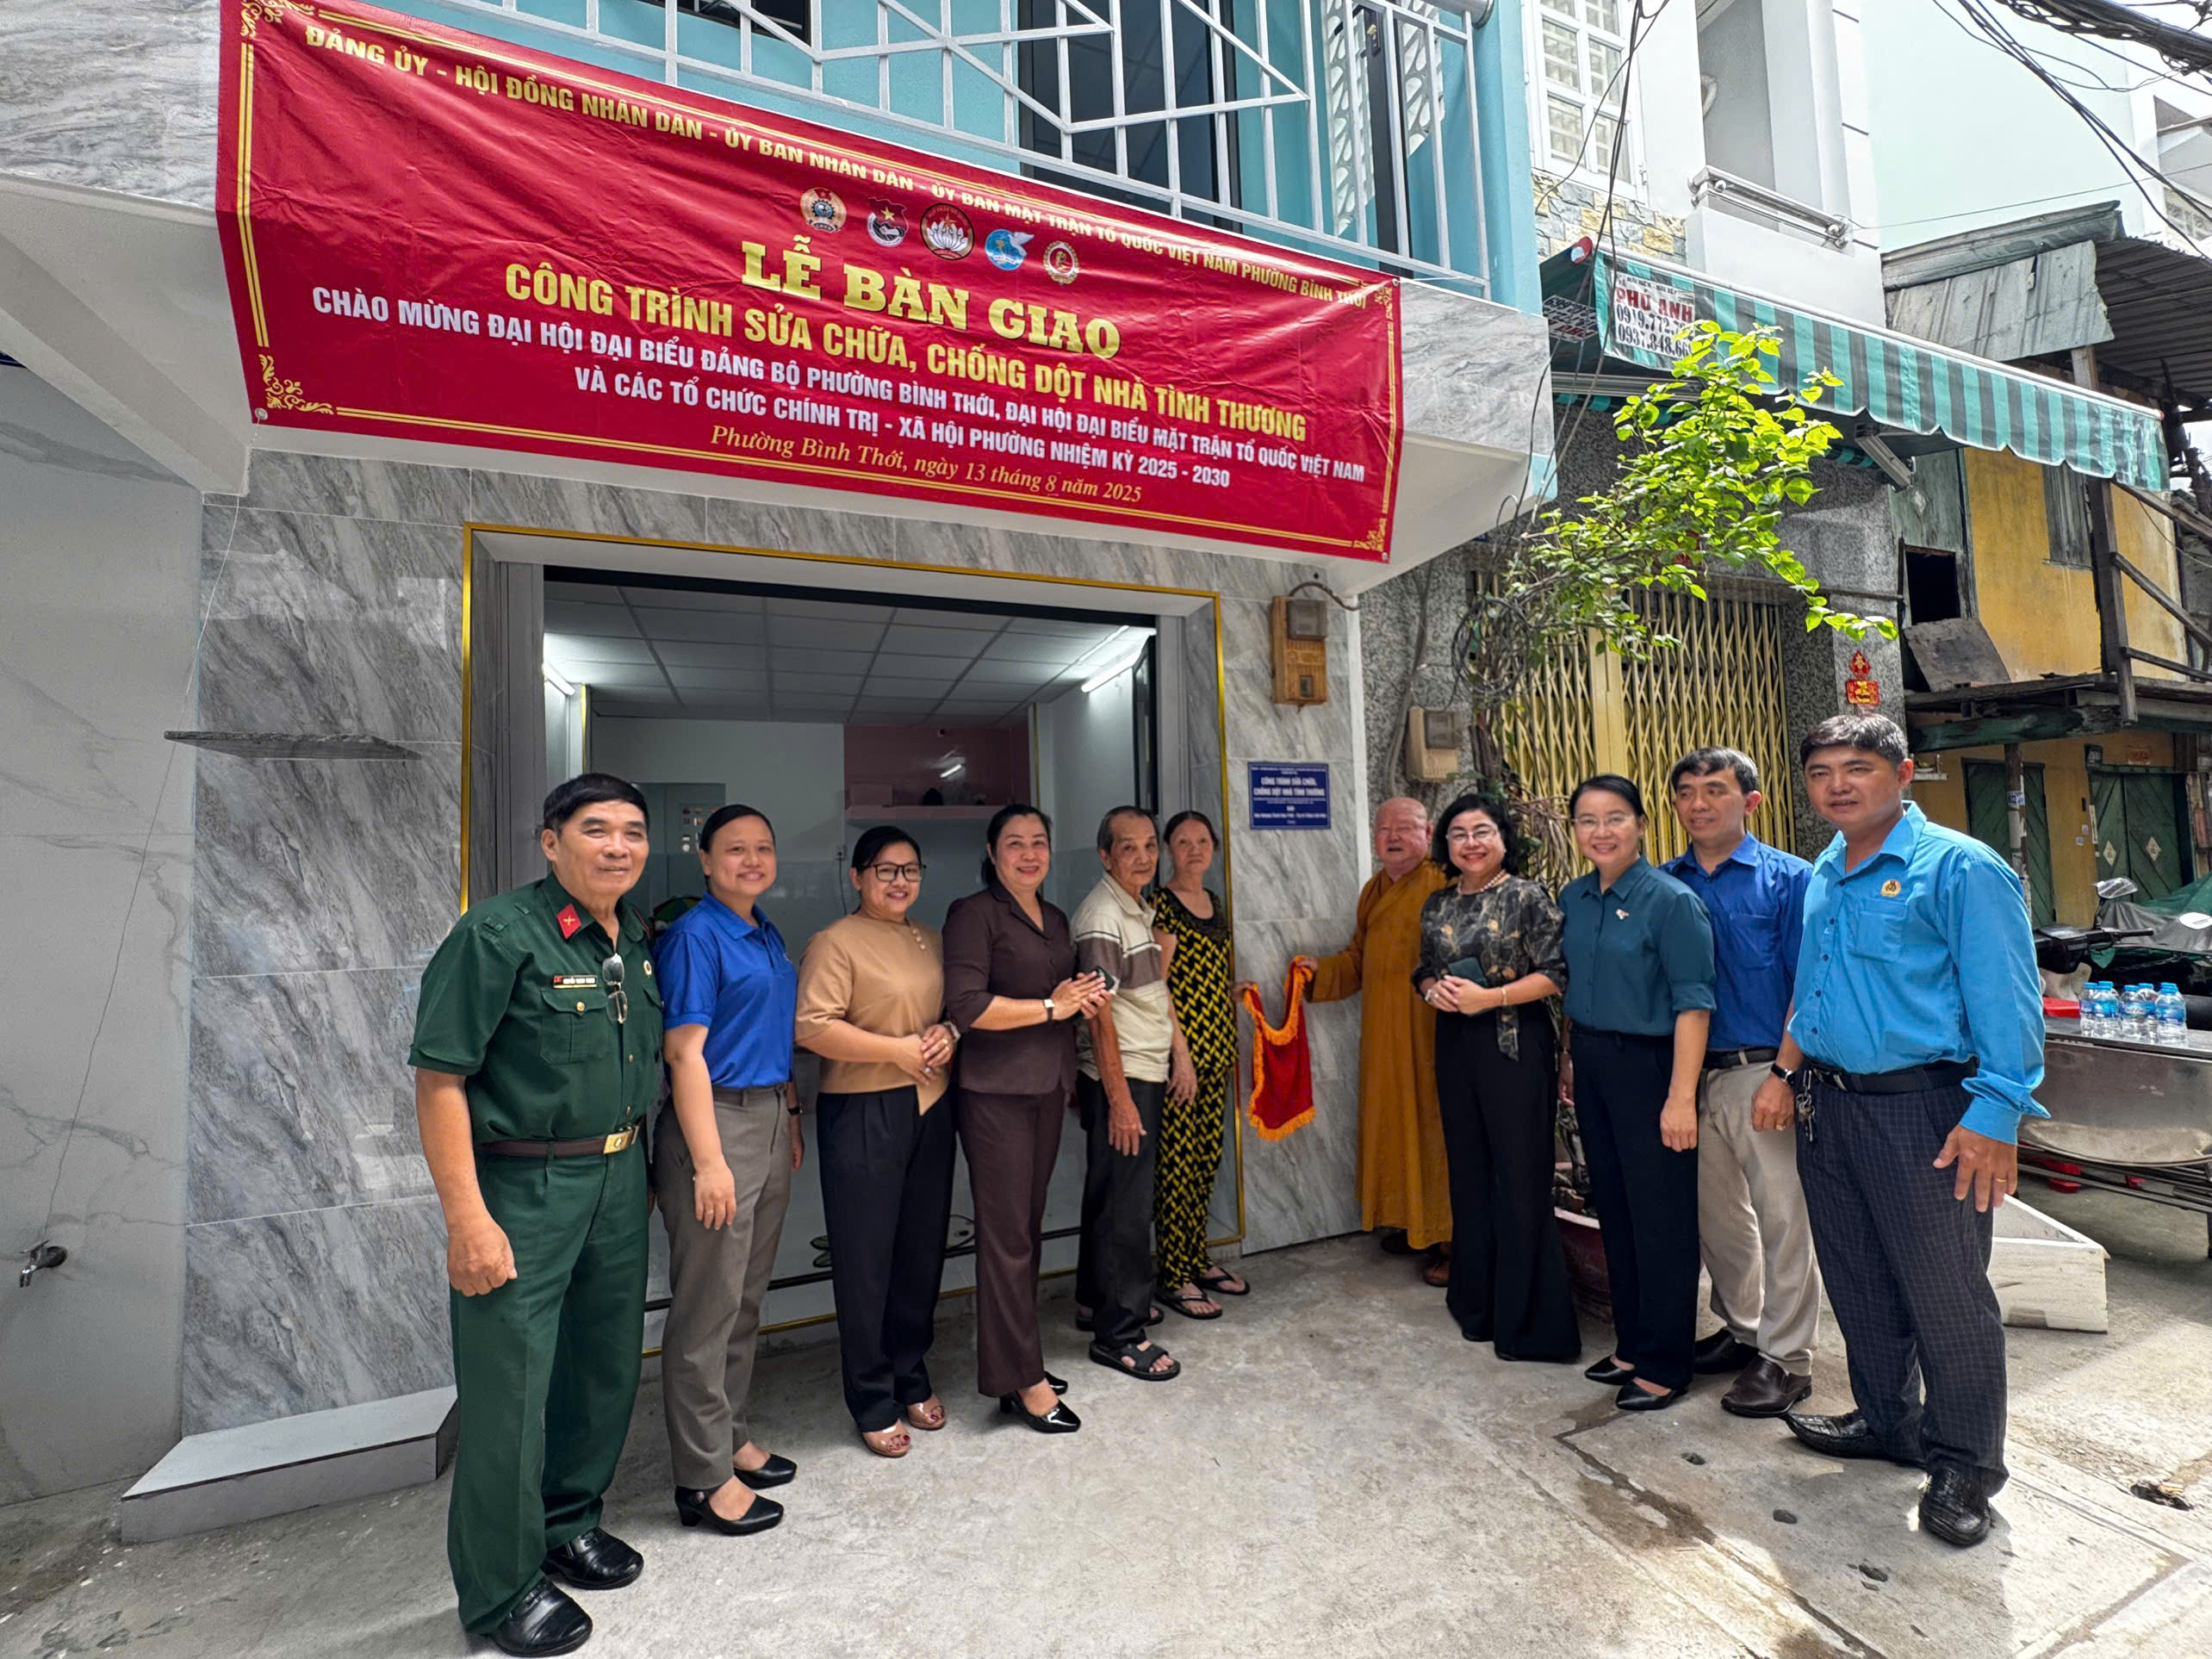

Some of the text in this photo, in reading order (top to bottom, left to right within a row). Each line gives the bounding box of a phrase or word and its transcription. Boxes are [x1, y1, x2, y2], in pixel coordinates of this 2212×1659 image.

[307, 24, 385, 65] ĐẢNG
[394, 45, 428, 77] ỦY
[456, 65, 498, 97] HỘI
[506, 74, 574, 112] ĐỒNG
[582, 87, 648, 128] NHÂN
[656, 107, 702, 140] DÂN
[725, 127, 753, 151] ỦY
[759, 139, 803, 164] BAN
[810, 149, 867, 179] NHÂN
[873, 168, 913, 190] DÂN
[932, 183, 955, 202] ỦY
[962, 192, 1000, 213] BAN
[1005, 206, 1041, 226] MẶT
[1047, 213, 1092, 238] TRẬN
[1097, 226, 1116, 242] TỔ
[1121, 232, 1164, 255] QUỐC
[1168, 245, 1199, 266] VIỆT
[1203, 253, 1238, 276] NAM
[1241, 262, 1297, 293] PHƯỜNG
[1300, 279, 1333, 302] BÌNH
[506, 262, 1305, 441] CÔNG TRÌNH SỬA CHỮA, CHỐNG DỘT NHÀ TÌNH THƯƠNG
[741, 235, 1122, 361] LỄ BÀN GIAO
[1619, 324, 1692, 357] 0937.848.66
[1658, 298, 1693, 323] ANH
[314, 288, 1364, 482] CHÀO MỪNG ĐẠI HỘI ĐẠI BIỂU ĐẢNG BỘ PHƯỜNG BÌNH THỚI, ĐẠI HỘI ĐẠI BIỂU MẶT TRẬN TỔ QUỐC VIỆT NAM
[575, 365, 606, 393] VÀ
[615, 372, 662, 400] CÁC
[670, 376, 699, 406] TỔ
[706, 388, 766, 415] CHỨC
[774, 398, 839, 426] CHÍNH
[847, 408, 878, 437] TRỊ
[899, 416, 925, 439] XÃ
[931, 421, 964, 449] HỘI
[970, 428, 1045, 458] PHƯỜNG
[1051, 436, 1107, 469] NHIỆM
[1113, 450, 1134, 471] KỲ
[1138, 457, 1177, 478] 2025
[1193, 465, 1229, 487] 2030
[711, 425, 1142, 503] Phường Bình Thới, ngày 13 tháng 8 năm 2025
